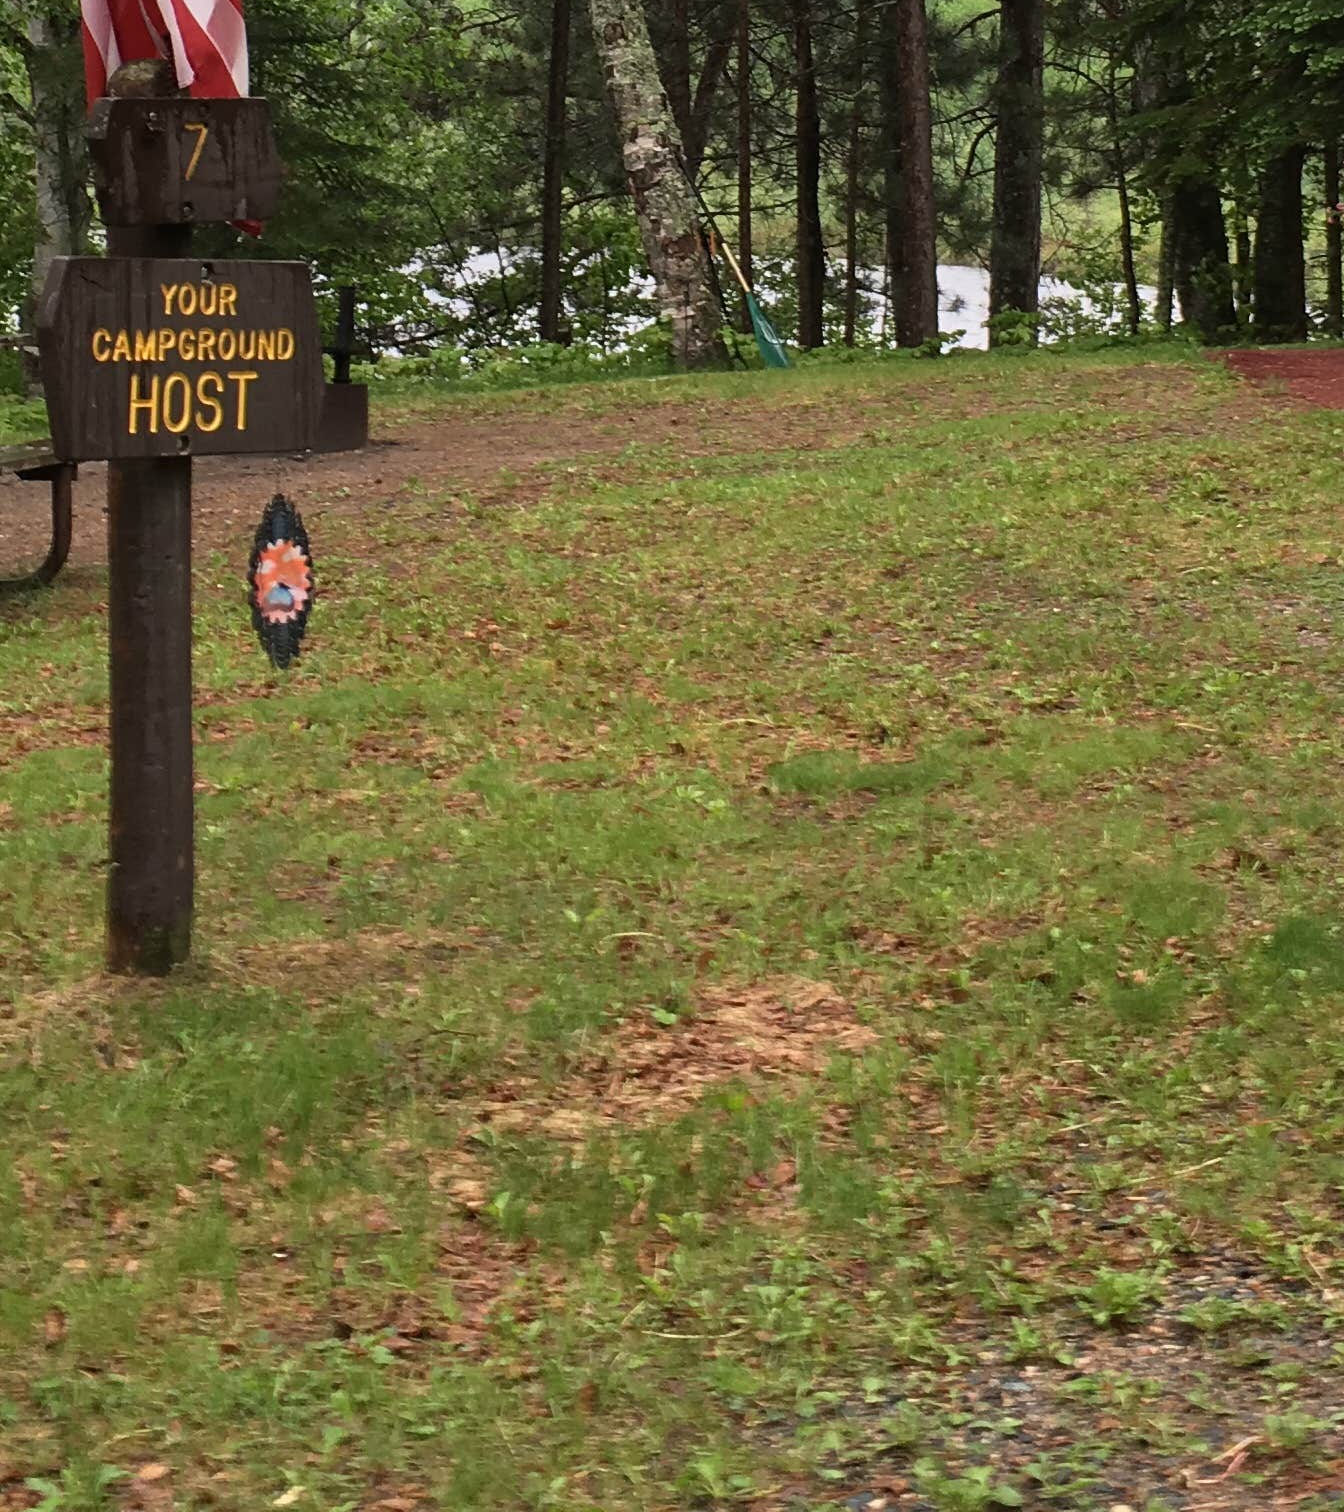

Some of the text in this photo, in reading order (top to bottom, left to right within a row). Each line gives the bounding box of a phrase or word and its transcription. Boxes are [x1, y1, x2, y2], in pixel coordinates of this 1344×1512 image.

[184, 122, 209, 182] 7
[160, 281, 238, 316] YOUR
[92, 327, 295, 363] CAMPGROUND
[128, 370, 260, 434] HOST
